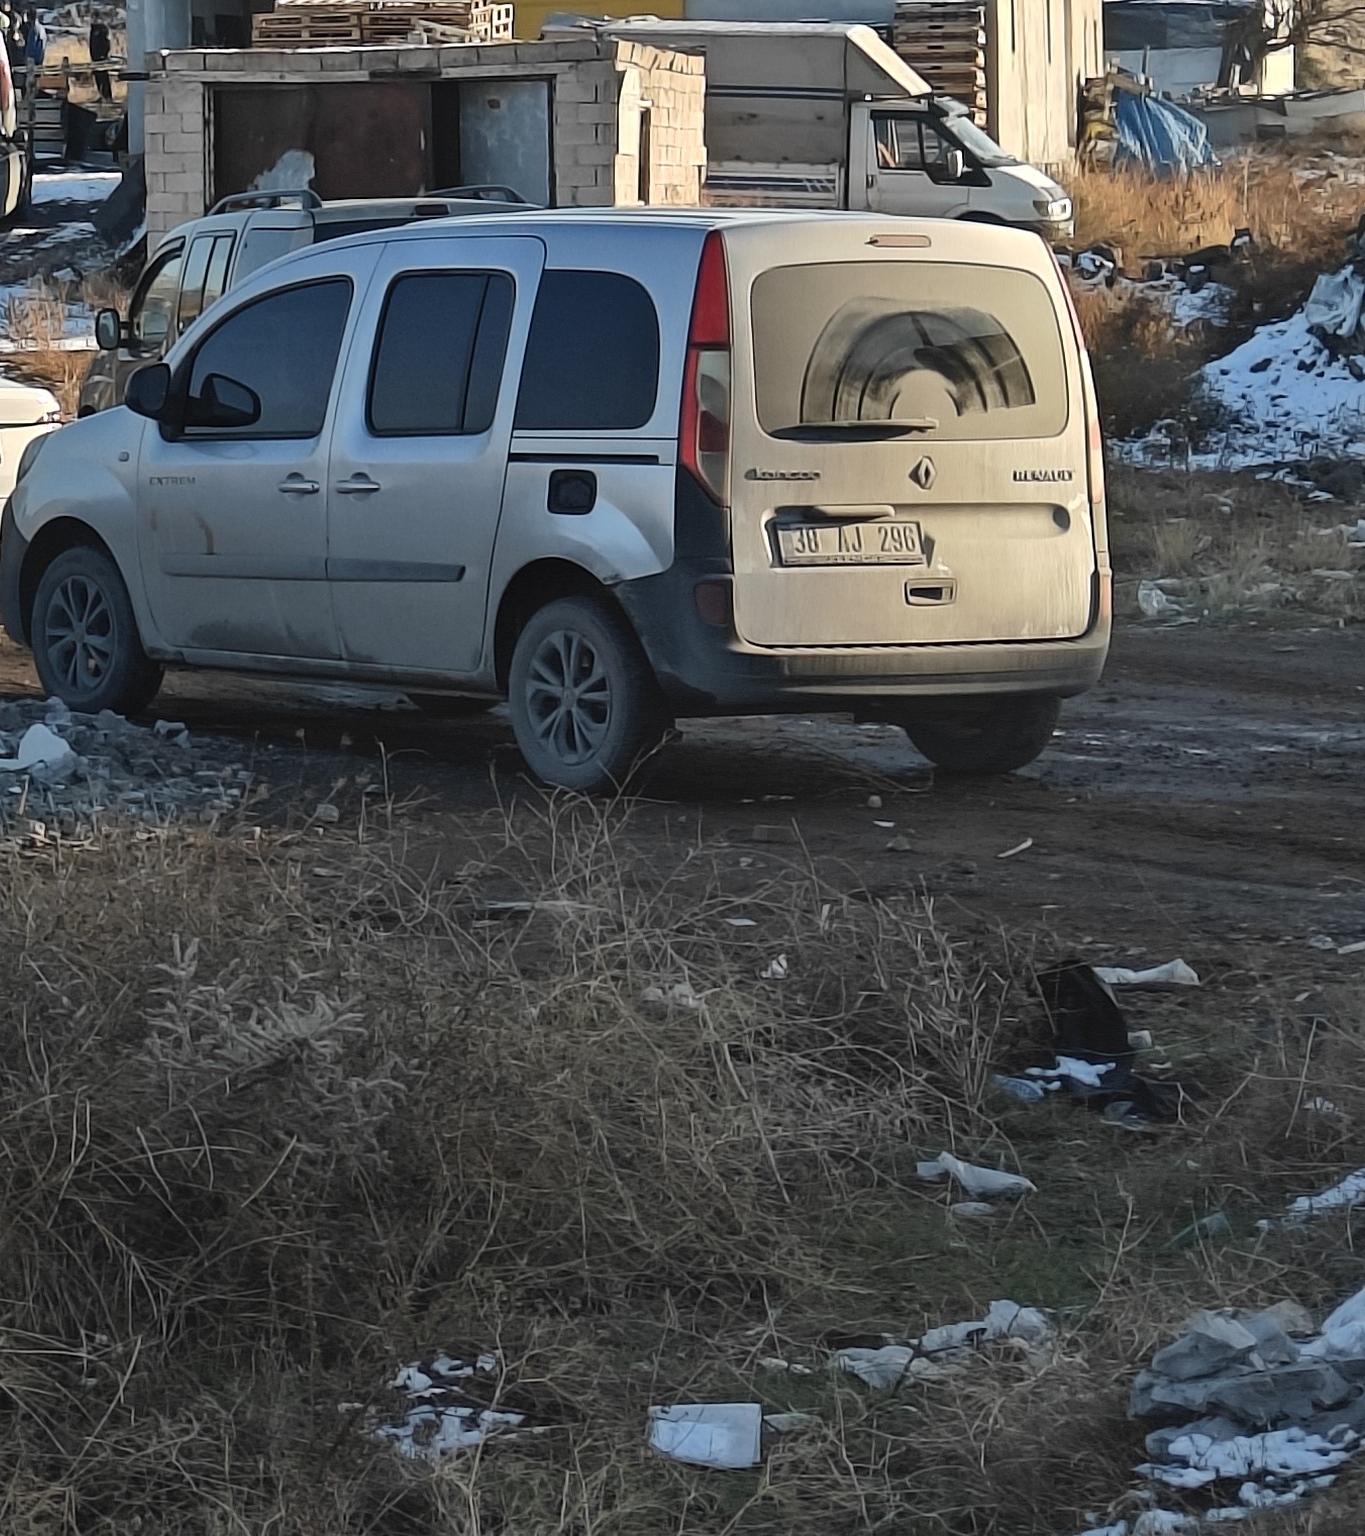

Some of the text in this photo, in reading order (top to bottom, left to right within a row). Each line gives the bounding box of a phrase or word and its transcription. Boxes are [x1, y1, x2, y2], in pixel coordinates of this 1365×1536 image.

[795, 525, 917, 554] 38 AJ 296
